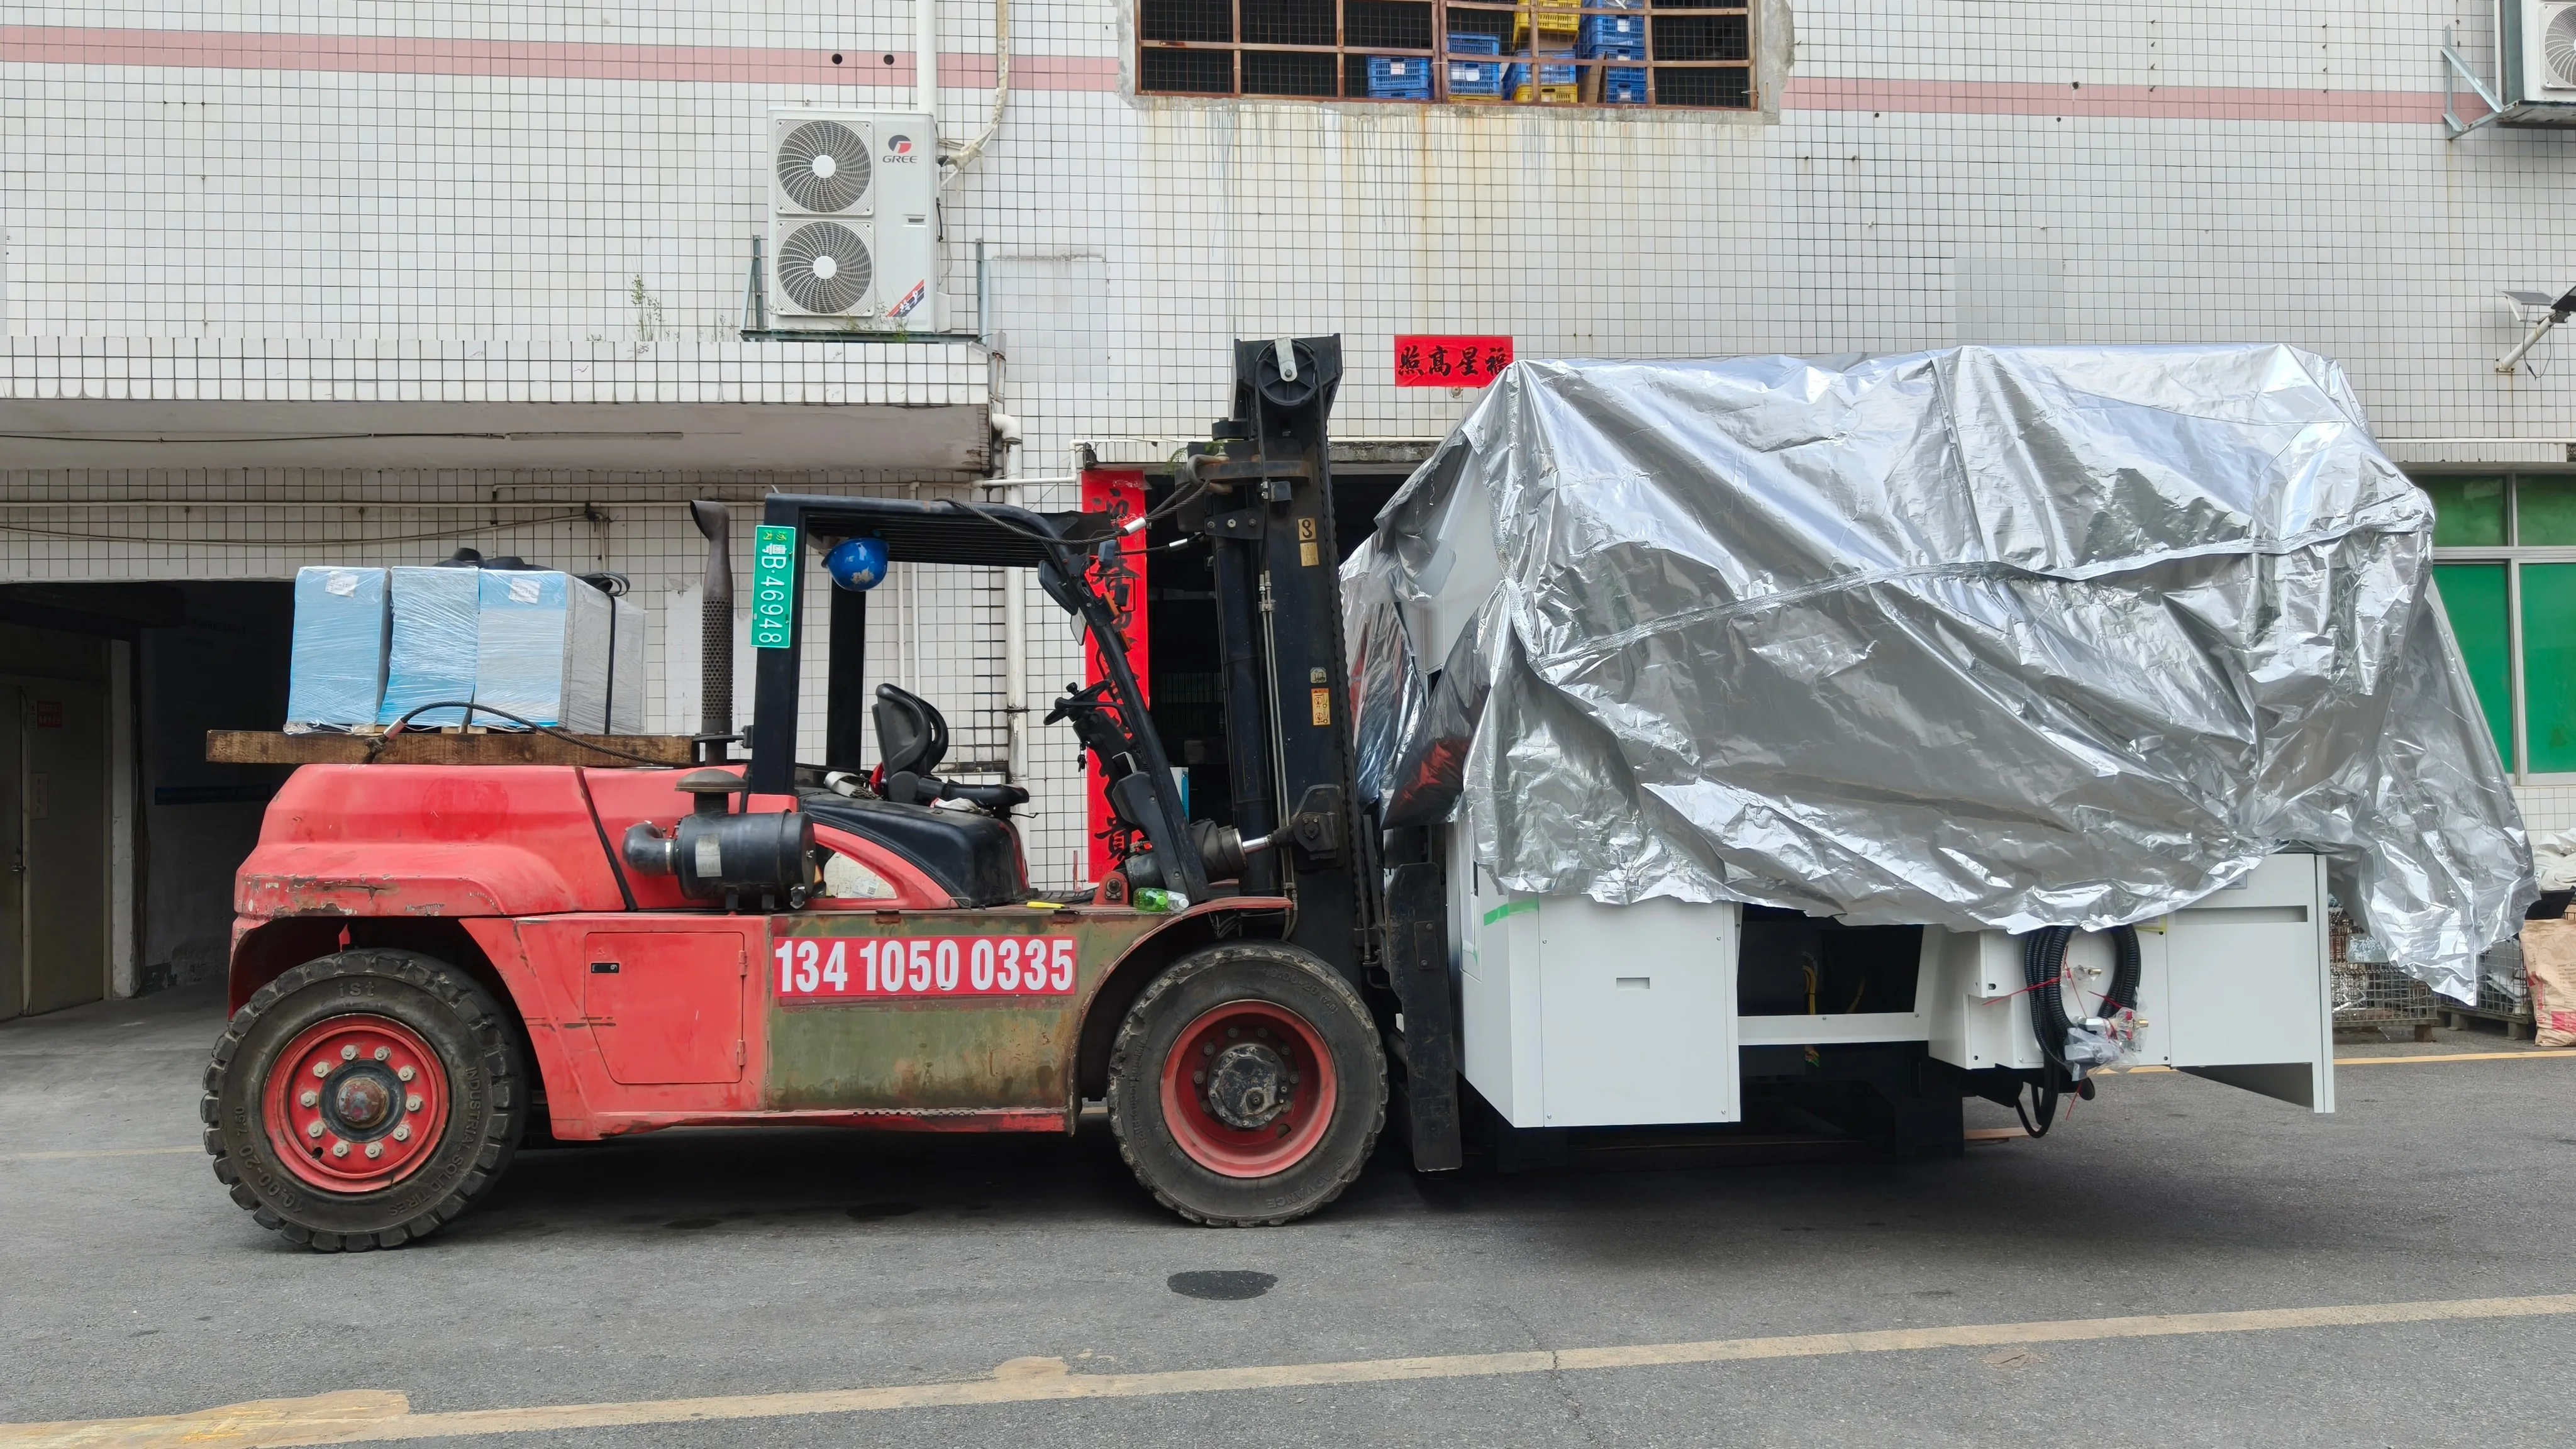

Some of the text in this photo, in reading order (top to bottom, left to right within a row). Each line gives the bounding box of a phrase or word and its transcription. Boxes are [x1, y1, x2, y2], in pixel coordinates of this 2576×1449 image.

[882, 155, 918, 164] GREE
[775, 939, 1073, 992] 134 1050 0335
[234, 1106, 303, 1214] 10.00-20 7.50
[388, 1067, 481, 1217] INDUSTRIAL SOLID TIRES
[1265, 1170, 1333, 1209] ADVANCE
